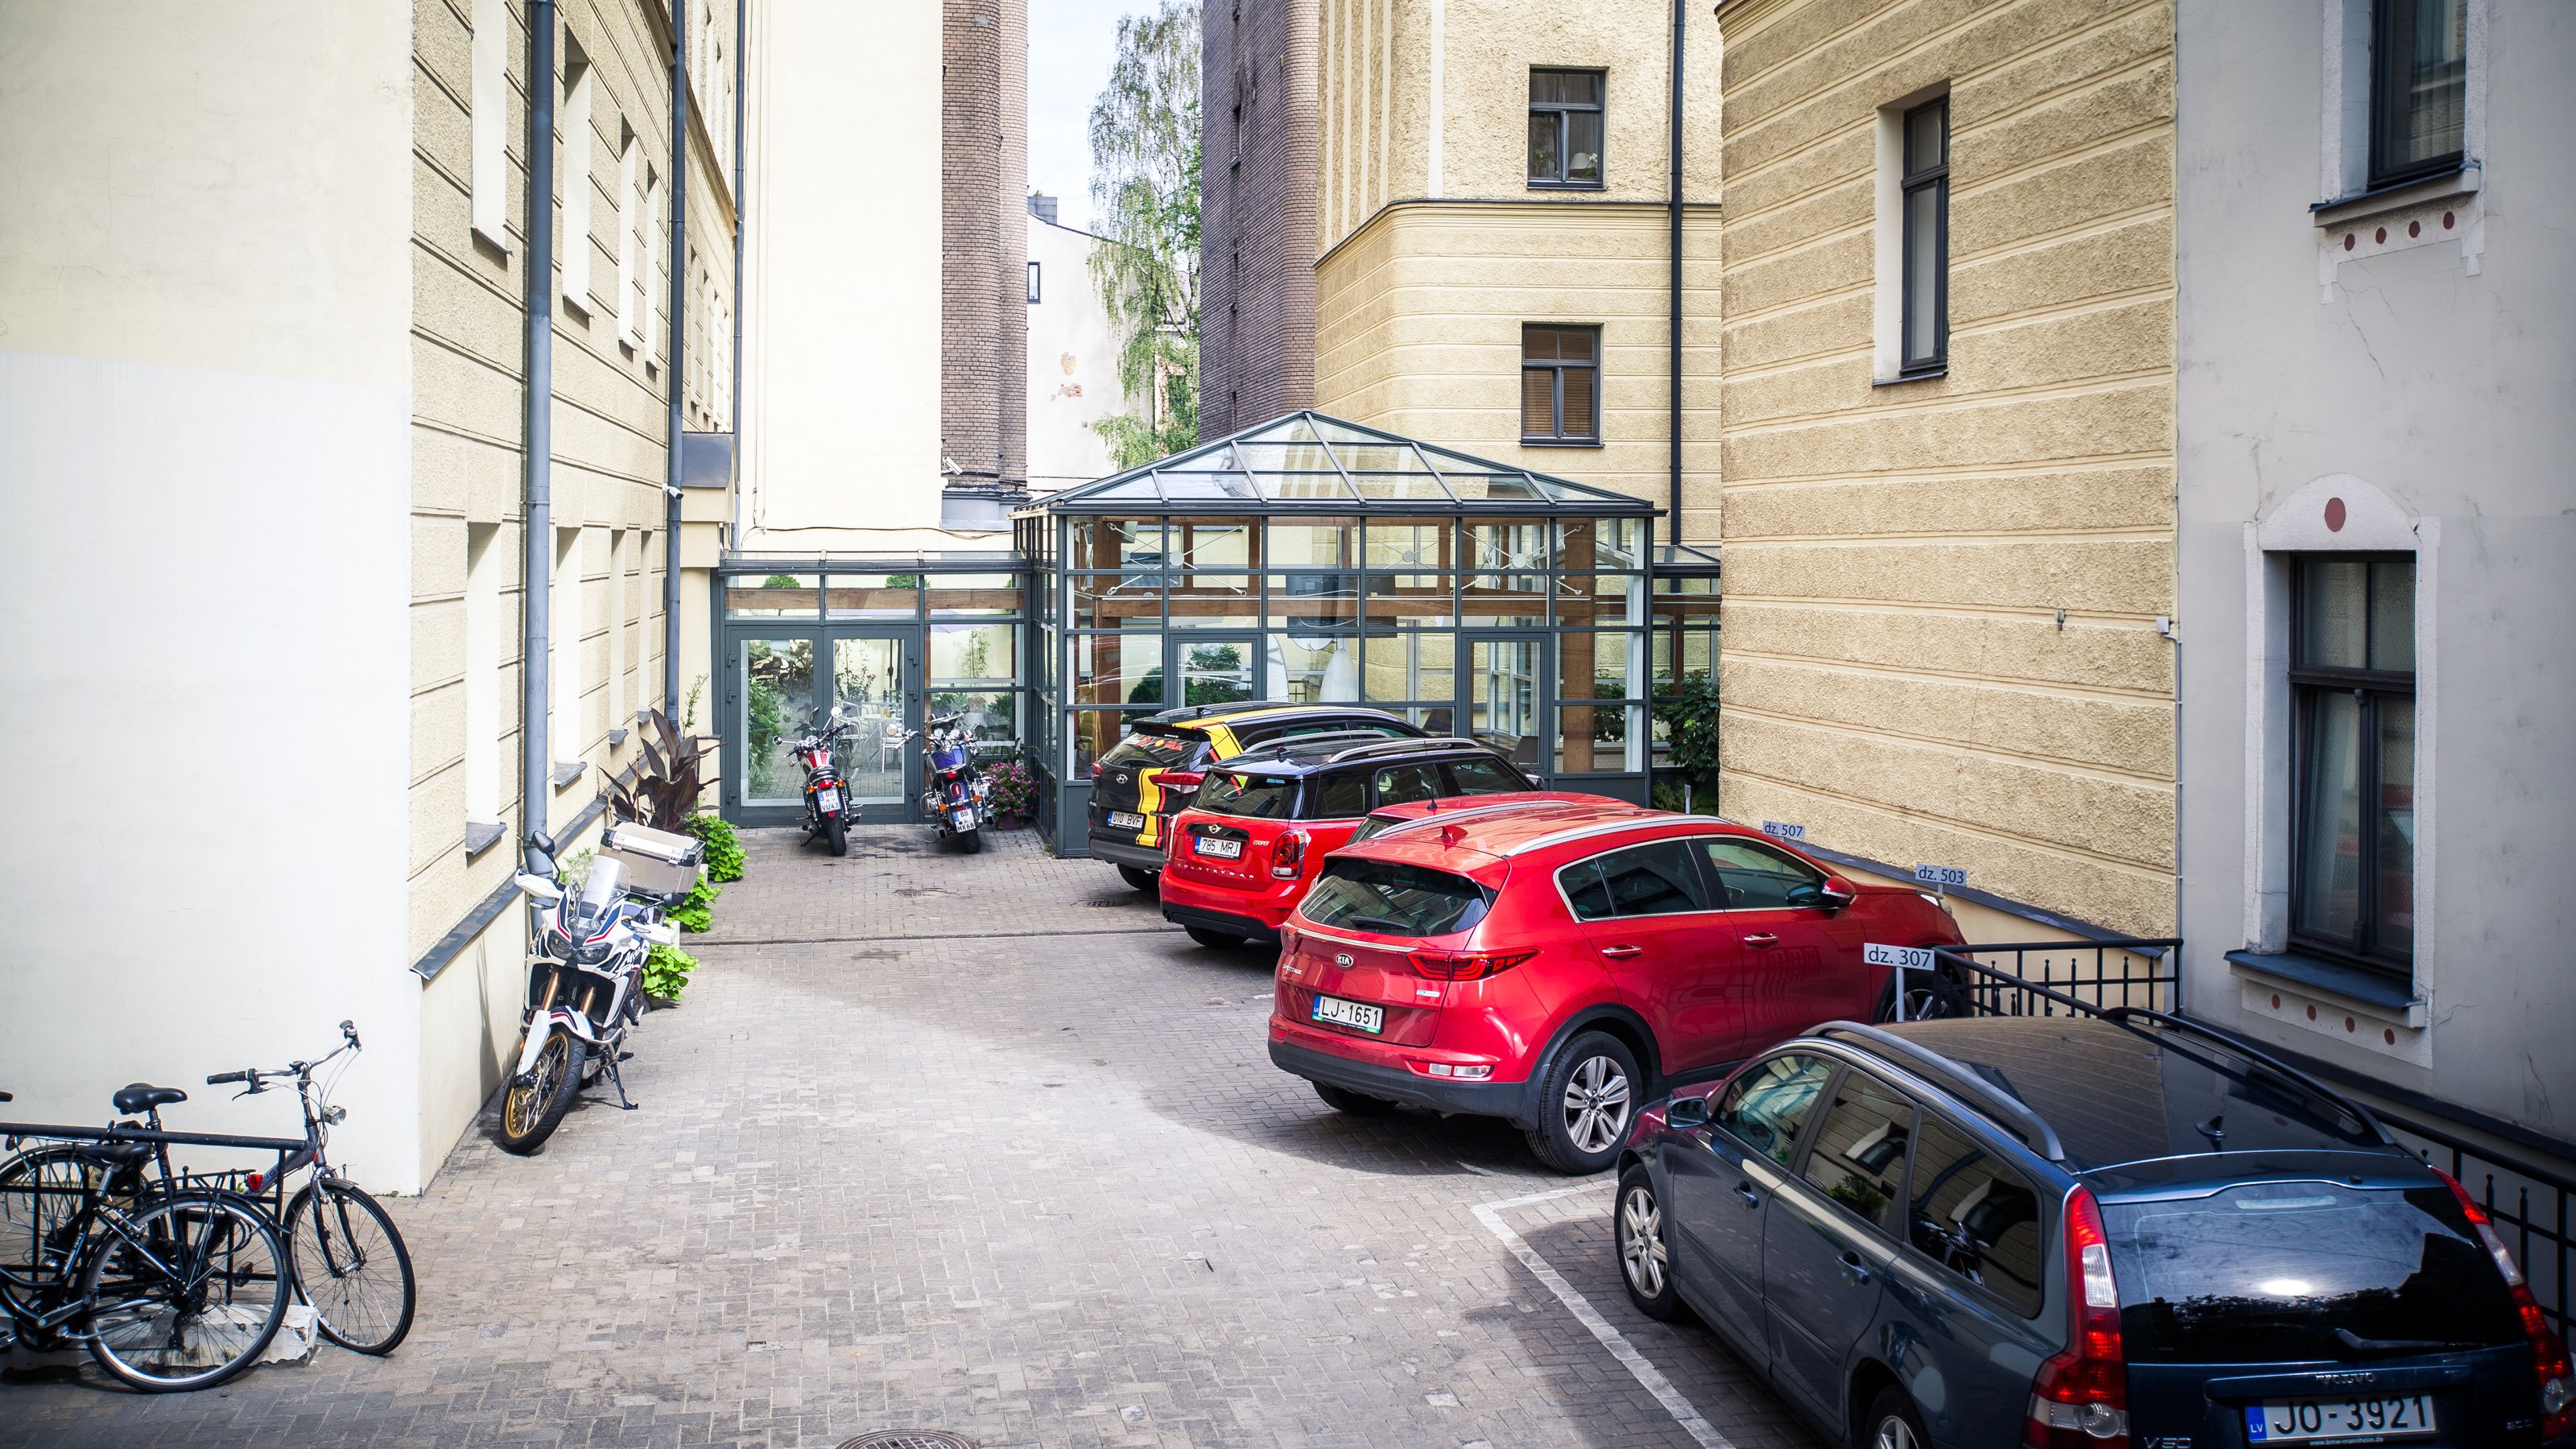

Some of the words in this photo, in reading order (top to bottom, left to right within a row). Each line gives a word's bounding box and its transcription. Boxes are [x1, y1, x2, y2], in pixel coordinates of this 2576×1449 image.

[1113, 812, 1125, 824] 010
[1126, 815, 1142, 826] BVF
[1765, 821, 1779, 835] dz.
[1781, 824, 1803, 837] 507
[1201, 839, 1216, 852] 785
[1220, 842, 1240, 855] MRJ
[1918, 865, 1937, 881] dz.
[1940, 869, 1964, 884] 503
[1337, 954, 1351, 966] KIA
[1868, 946, 1893, 964] dz.
[1899, 949, 1931, 967] 307
[1321, 998, 1379, 1026] LJ-1651
[2250, 1423, 2264, 1434] LV
[2273, 1393, 2427, 1435] JO-3921
[2308, 1436, 2384, 1447] www.bmw-mannheim.de
